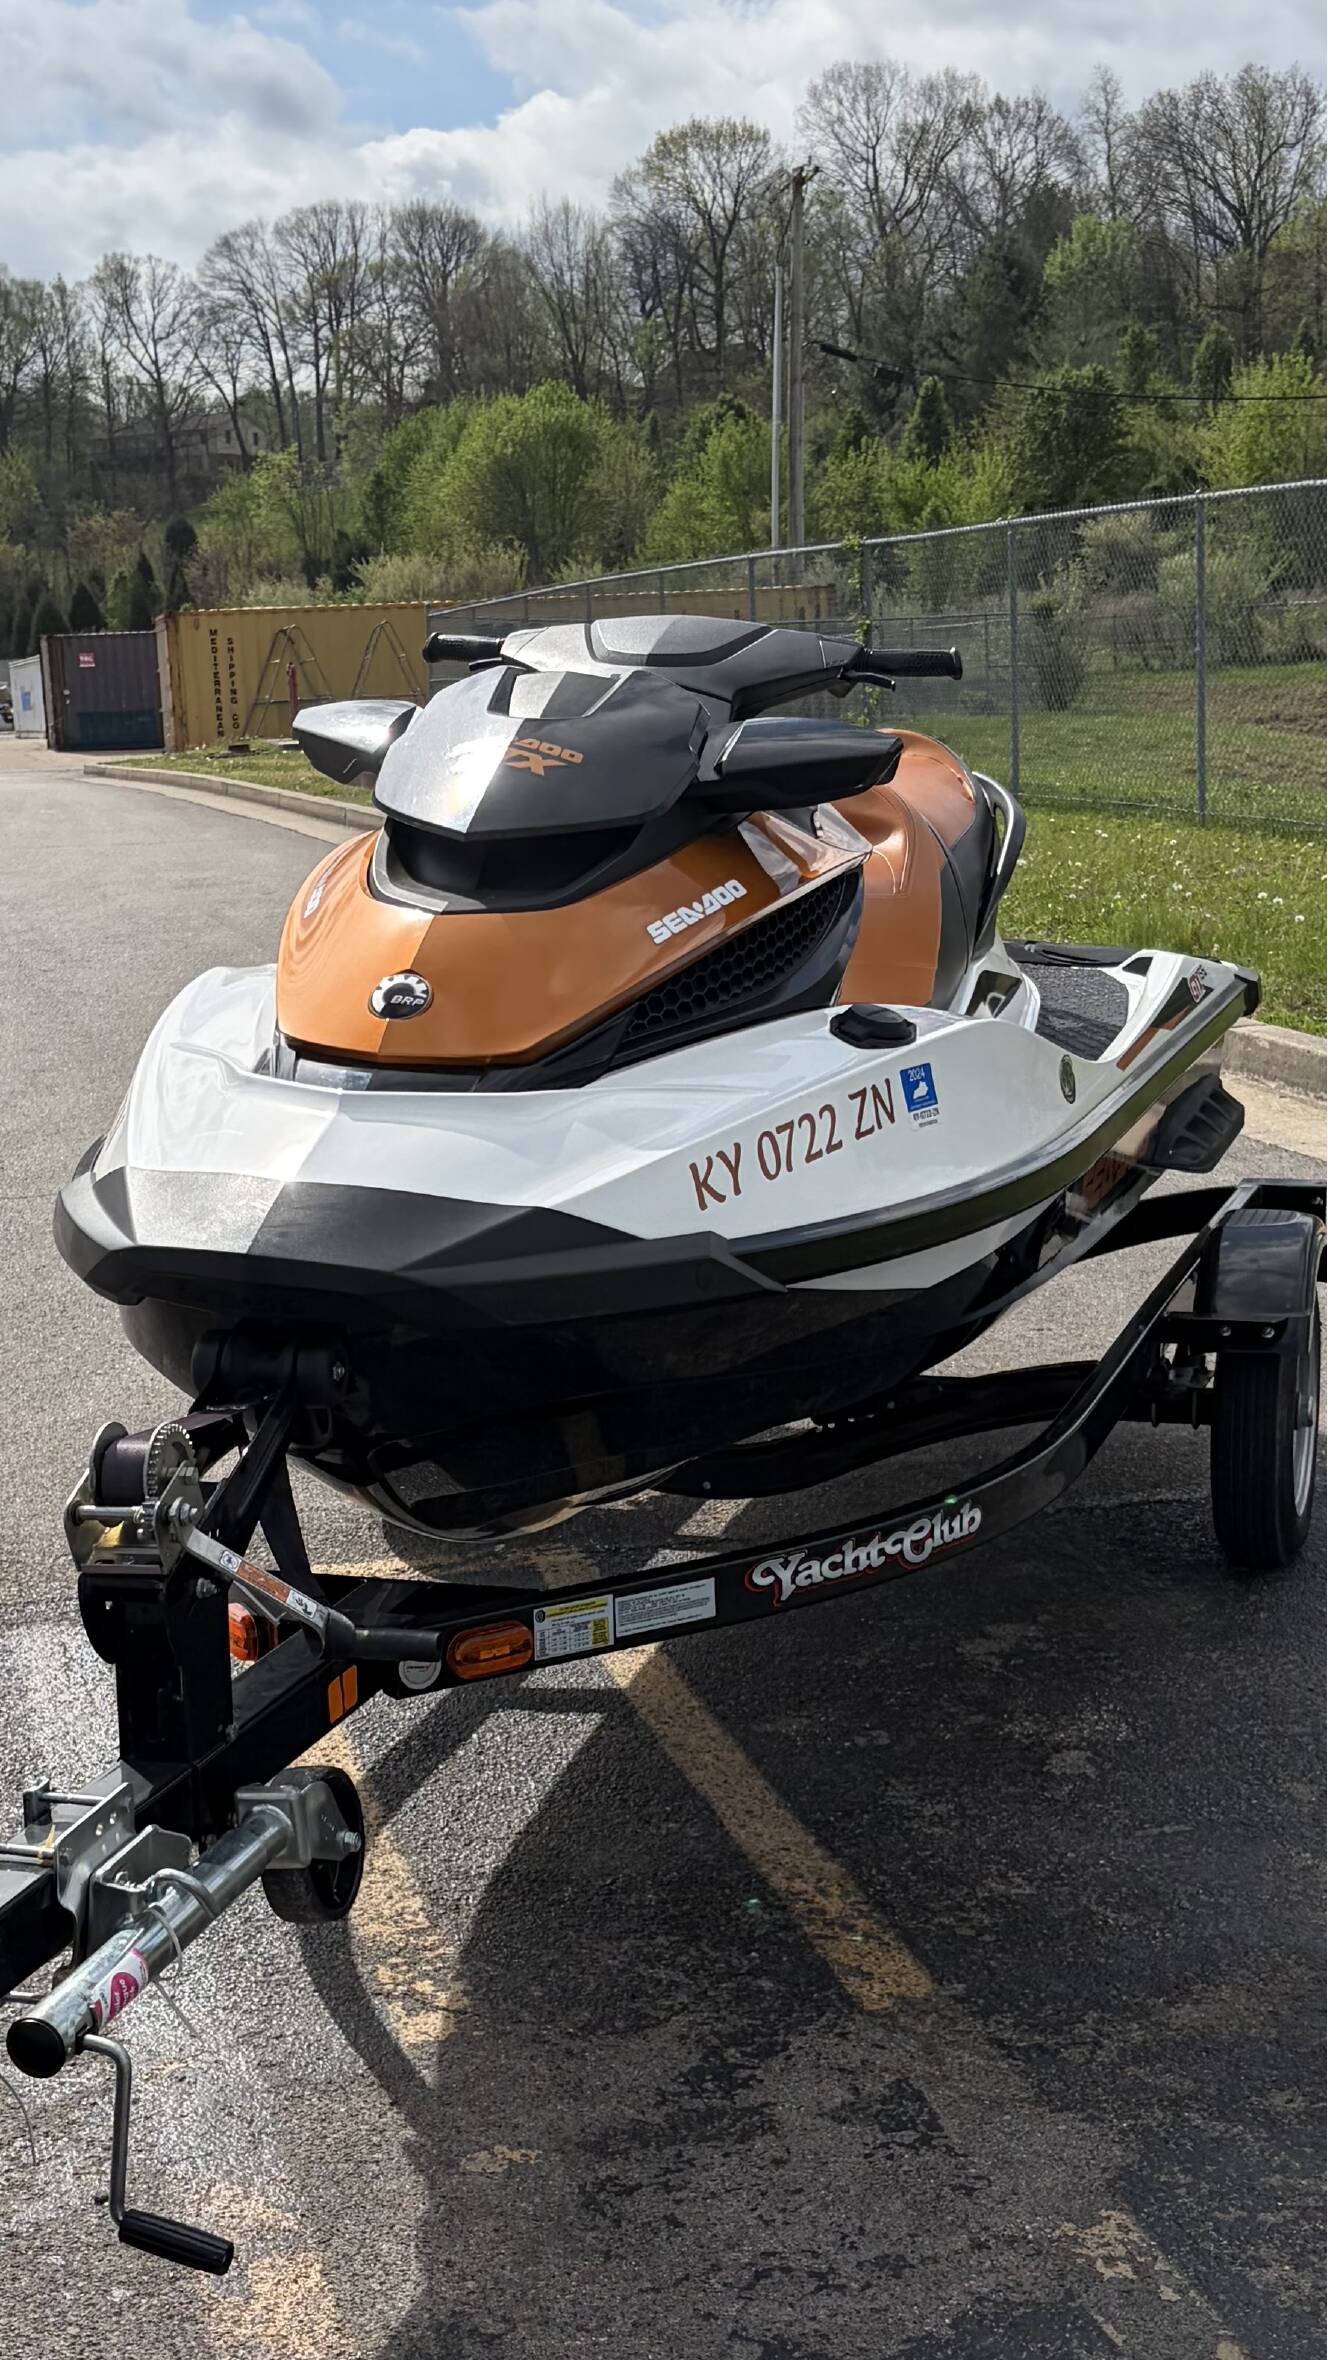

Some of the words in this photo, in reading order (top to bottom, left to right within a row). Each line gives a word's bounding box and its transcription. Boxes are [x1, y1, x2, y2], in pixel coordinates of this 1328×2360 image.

[209, 628, 225, 738] MEDITERRANEAN
[226, 637, 238, 705] SHIPPING
[231, 713, 240, 730] CO
[390, 994, 425, 1007] BRP
[907, 1066, 926, 1082] 2024
[688, 1142, 742, 1211] KY
[756, 1104, 843, 1181] 0722
[847, 1078, 896, 1140] ZN
[751, 1532, 885, 1602] Yacht
[885, 1502, 982, 1564] Club
